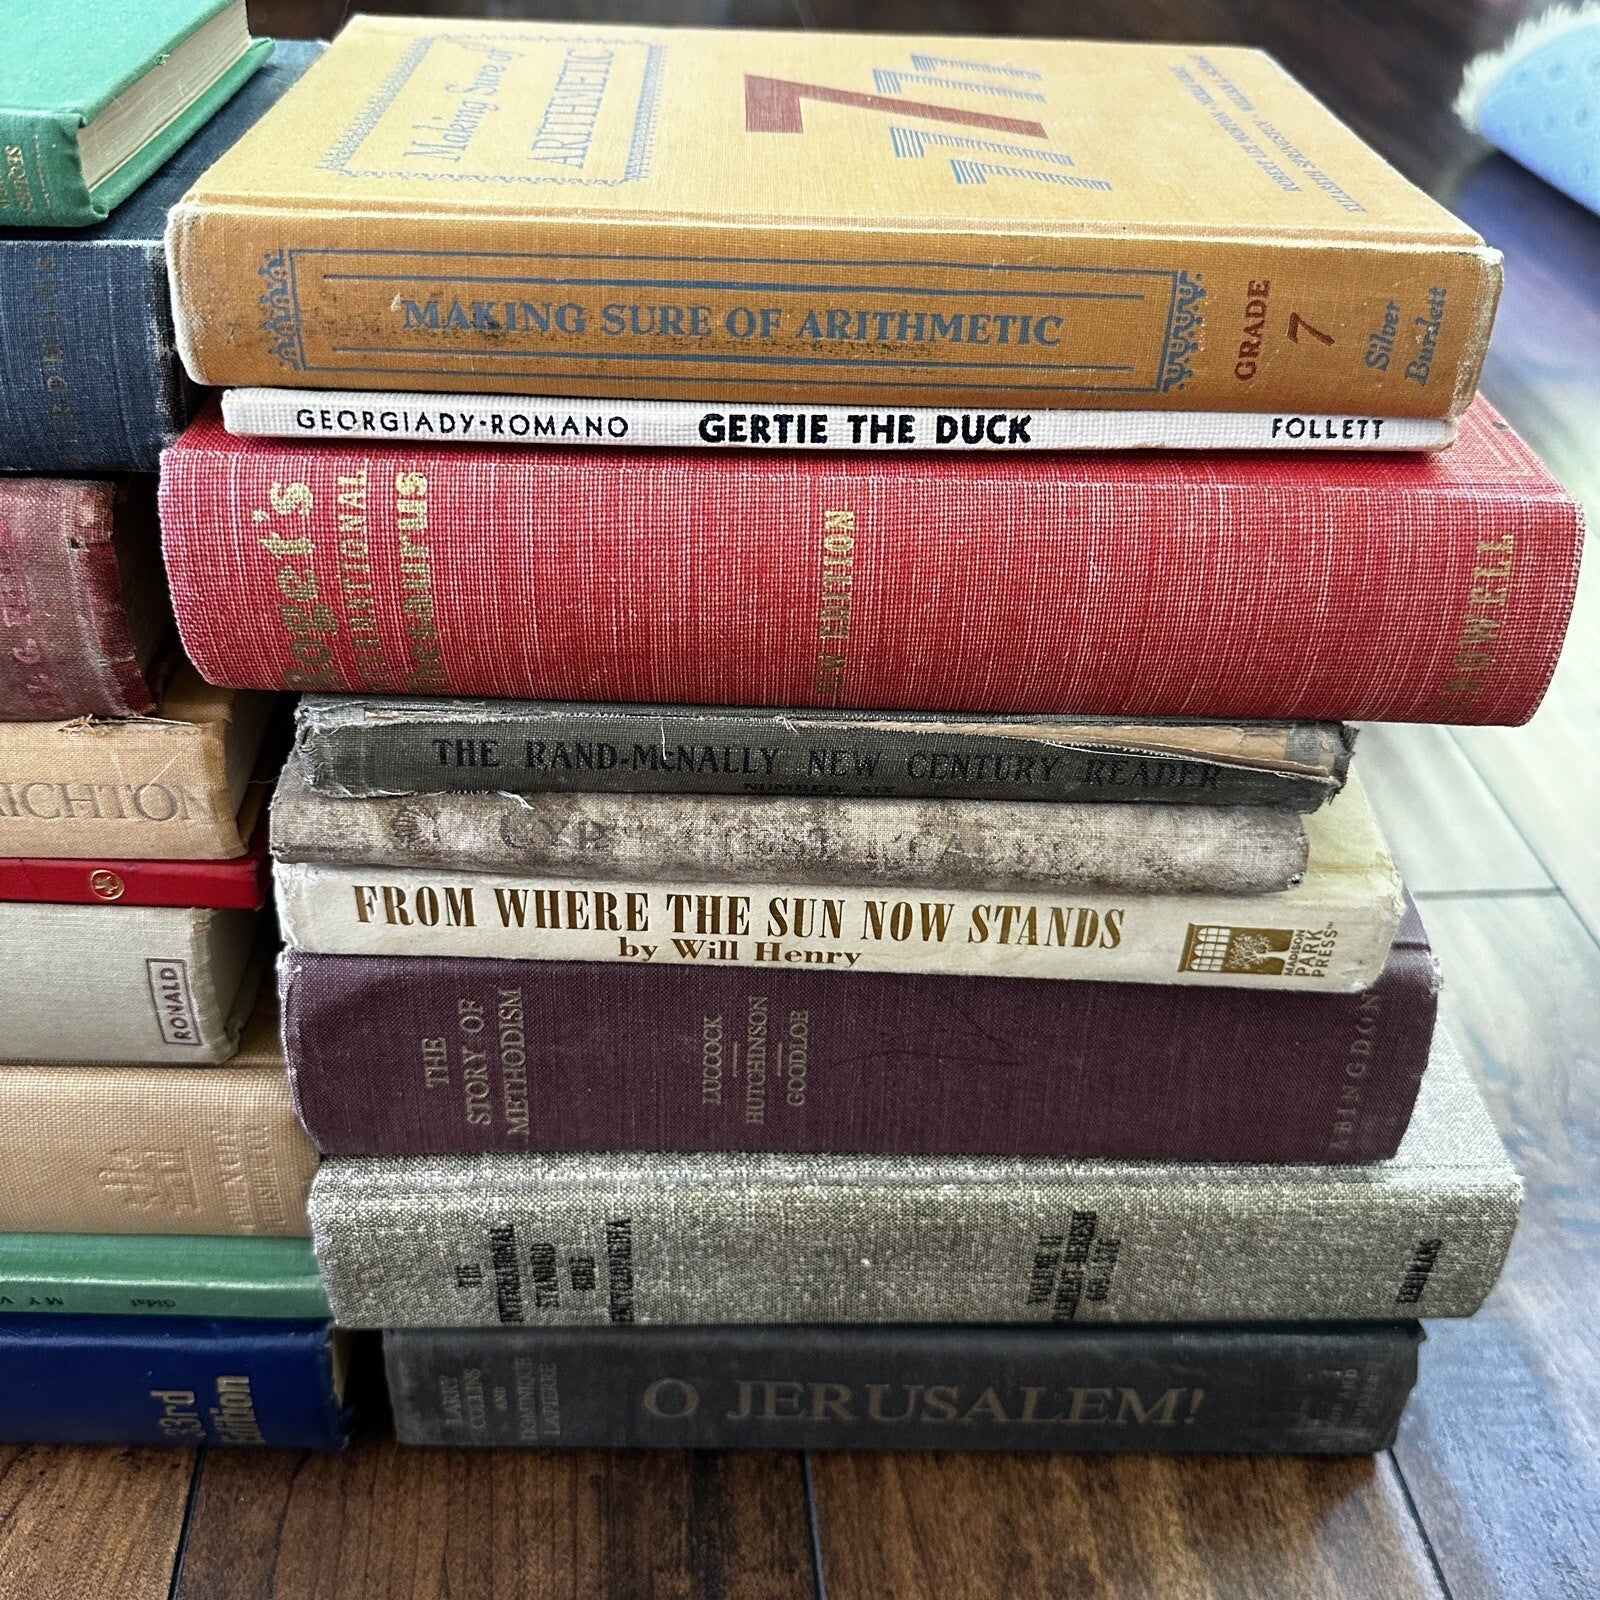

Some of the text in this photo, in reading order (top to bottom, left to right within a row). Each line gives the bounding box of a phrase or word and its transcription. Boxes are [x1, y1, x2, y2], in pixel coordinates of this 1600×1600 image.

[445, 63, 507, 97] Sure
[526, 47, 614, 170] ARITHMETIC
[744, 74, 1048, 139] 7
[402, 100, 499, 162] Making
[403, 299, 1064, 346] MAKING SURE OF ARITHMETIC
[1234, 280, 1271, 382] GRADE
[1287, 312, 1335, 346] 7
[1365, 300, 1400, 372] Silver
[1404, 285, 1447, 387] Burdett
[699, 413, 1032, 445] GERTIE THE DUCK
[1272, 418, 1384, 439] FOLLETT
[252, 481, 347, 688] Roget's
[396, 471, 451, 692] Thesaurus
[819, 510, 855, 639] EDITION
[1434, 535, 1515, 711] CROWELL
[433, 739, 501, 767] THE
[806, 749, 880, 779] NEW
[906, 753, 1062, 783] CENTURY
[1082, 758, 1223, 790] READER
[352, 884, 1124, 949] FROM WHERE THE SUN NOW STANDS
[618, 936, 862, 967] by Will Henry
[1283, 929, 1305, 976] MADISON
[1294, 929, 1323, 977] PARK
[160, 967, 193, 1040] RONALD
[422, 1037, 450, 1087] THE
[458, 999, 492, 1125] STORY OF
[498, 987, 530, 1135] METHODISM
[702, 1013, 722, 1104] LUCCOCK
[746, 994, 768, 1124] HUTCHINSON
[786, 1010, 808, 1106] GOODLOE
[643, 1379, 1203, 1425] O JERUSALEM!
